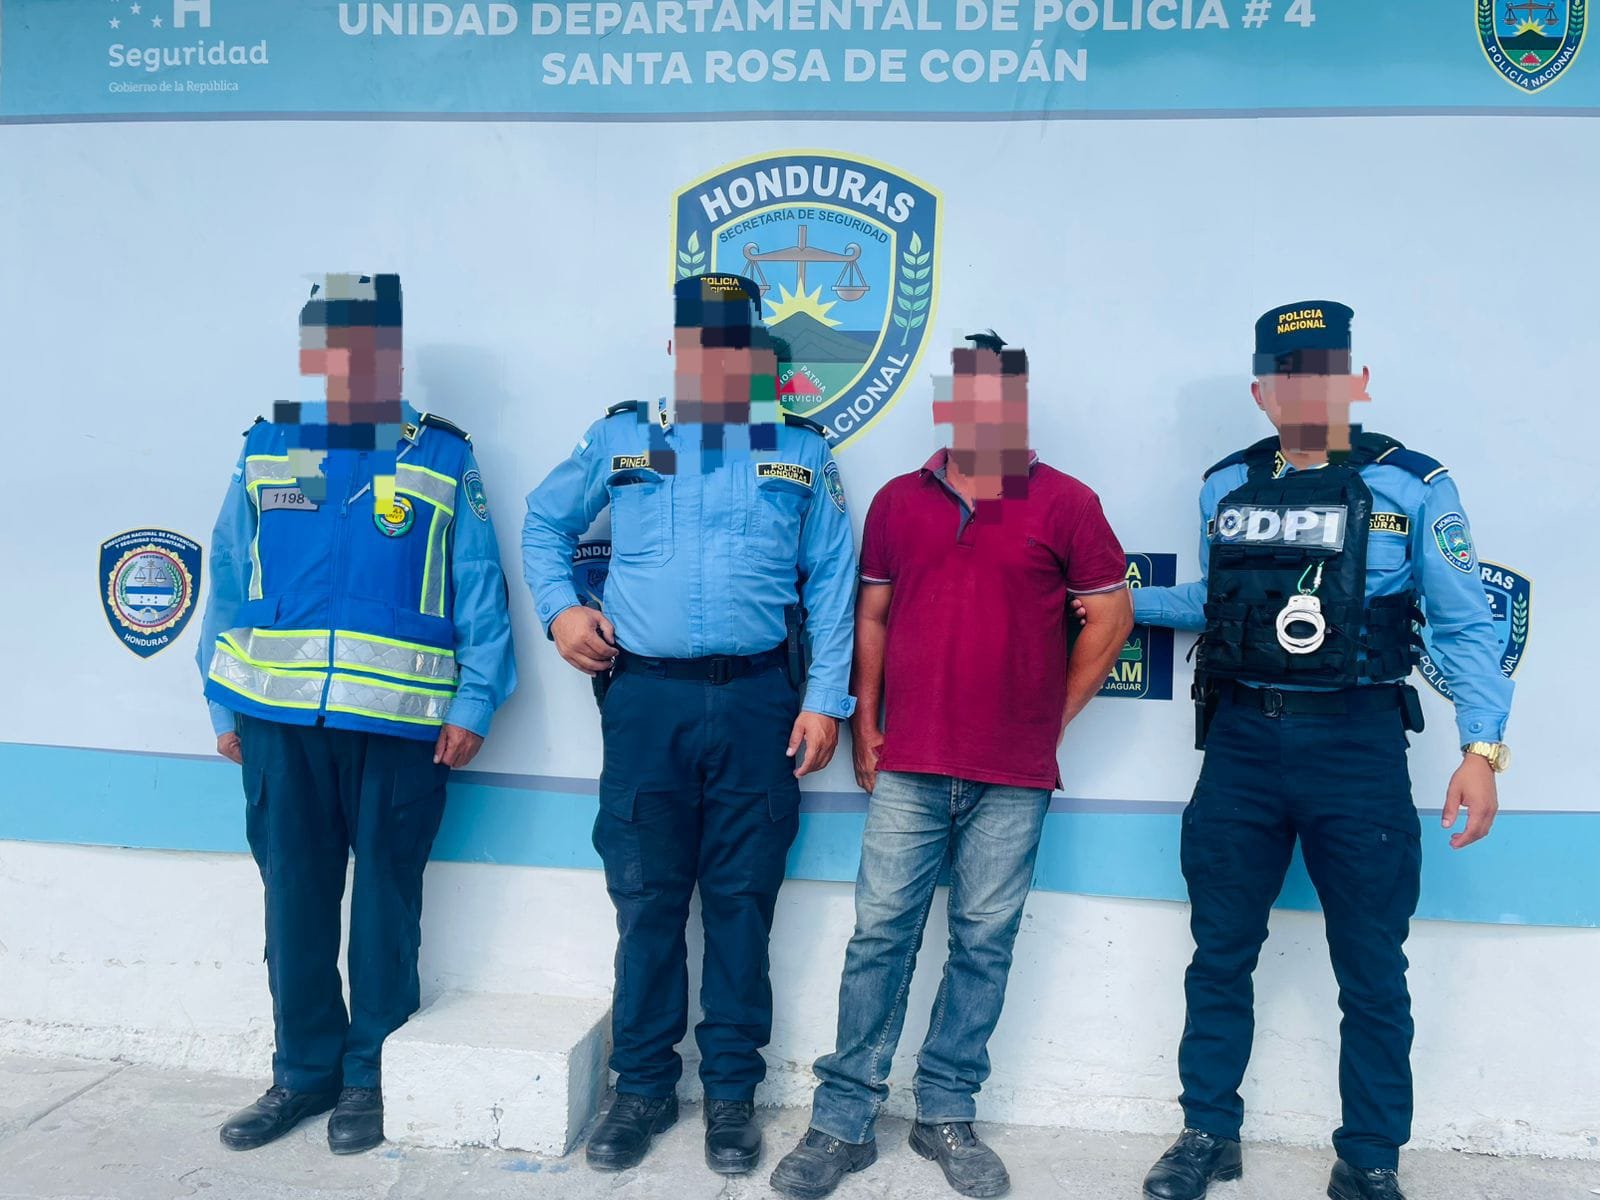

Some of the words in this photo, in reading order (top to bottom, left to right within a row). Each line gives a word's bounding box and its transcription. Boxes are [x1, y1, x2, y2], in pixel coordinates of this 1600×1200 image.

[338, 3, 519, 36] UNIDAD
[531, 0, 943, 36] DEPARTAMENTAL
[955, 0, 1018, 31] DE
[1241, 0, 1272, 29] #
[1284, 0, 1316, 28] 4
[108, 39, 269, 73] Seguridad
[542, 51, 693, 86] SANTA
[705, 48, 831, 84] ROSA
[844, 48, 907, 83] DE
[920, 39, 1088, 84] COPÁN
[1531, 45, 1576, 87] NACIONAL
[108, 82, 158, 93] Gobierno
[159, 81, 173, 92] de
[174, 81, 184, 92] la
[186, 80, 239, 93] República
[699, 164, 916, 223] HONDURAS
[719, 208, 796, 243] SECRETARÍA
[799, 209, 815, 220] DE
[818, 211, 888, 245] SEGURIDAD
[1279, 309, 1324, 323] POLICIA
[1277, 319, 1327, 335] NACIONAL
[780, 369, 794, 385] IOS
[801, 365, 826, 393] PATRIA
[825, 353, 909, 440] ACIONAL
[620, 457, 650, 468] PINED
[771, 463, 804, 475] POLICIA
[763, 469, 807, 483] HONDURAS
[273, 492, 305, 504] 1198
[1246, 510, 1339, 543] DPI
[573, 546, 612, 559] ONDU
[124, 633, 168, 647] HONDURAS
[1105, 683, 1142, 691] JAGUAR
